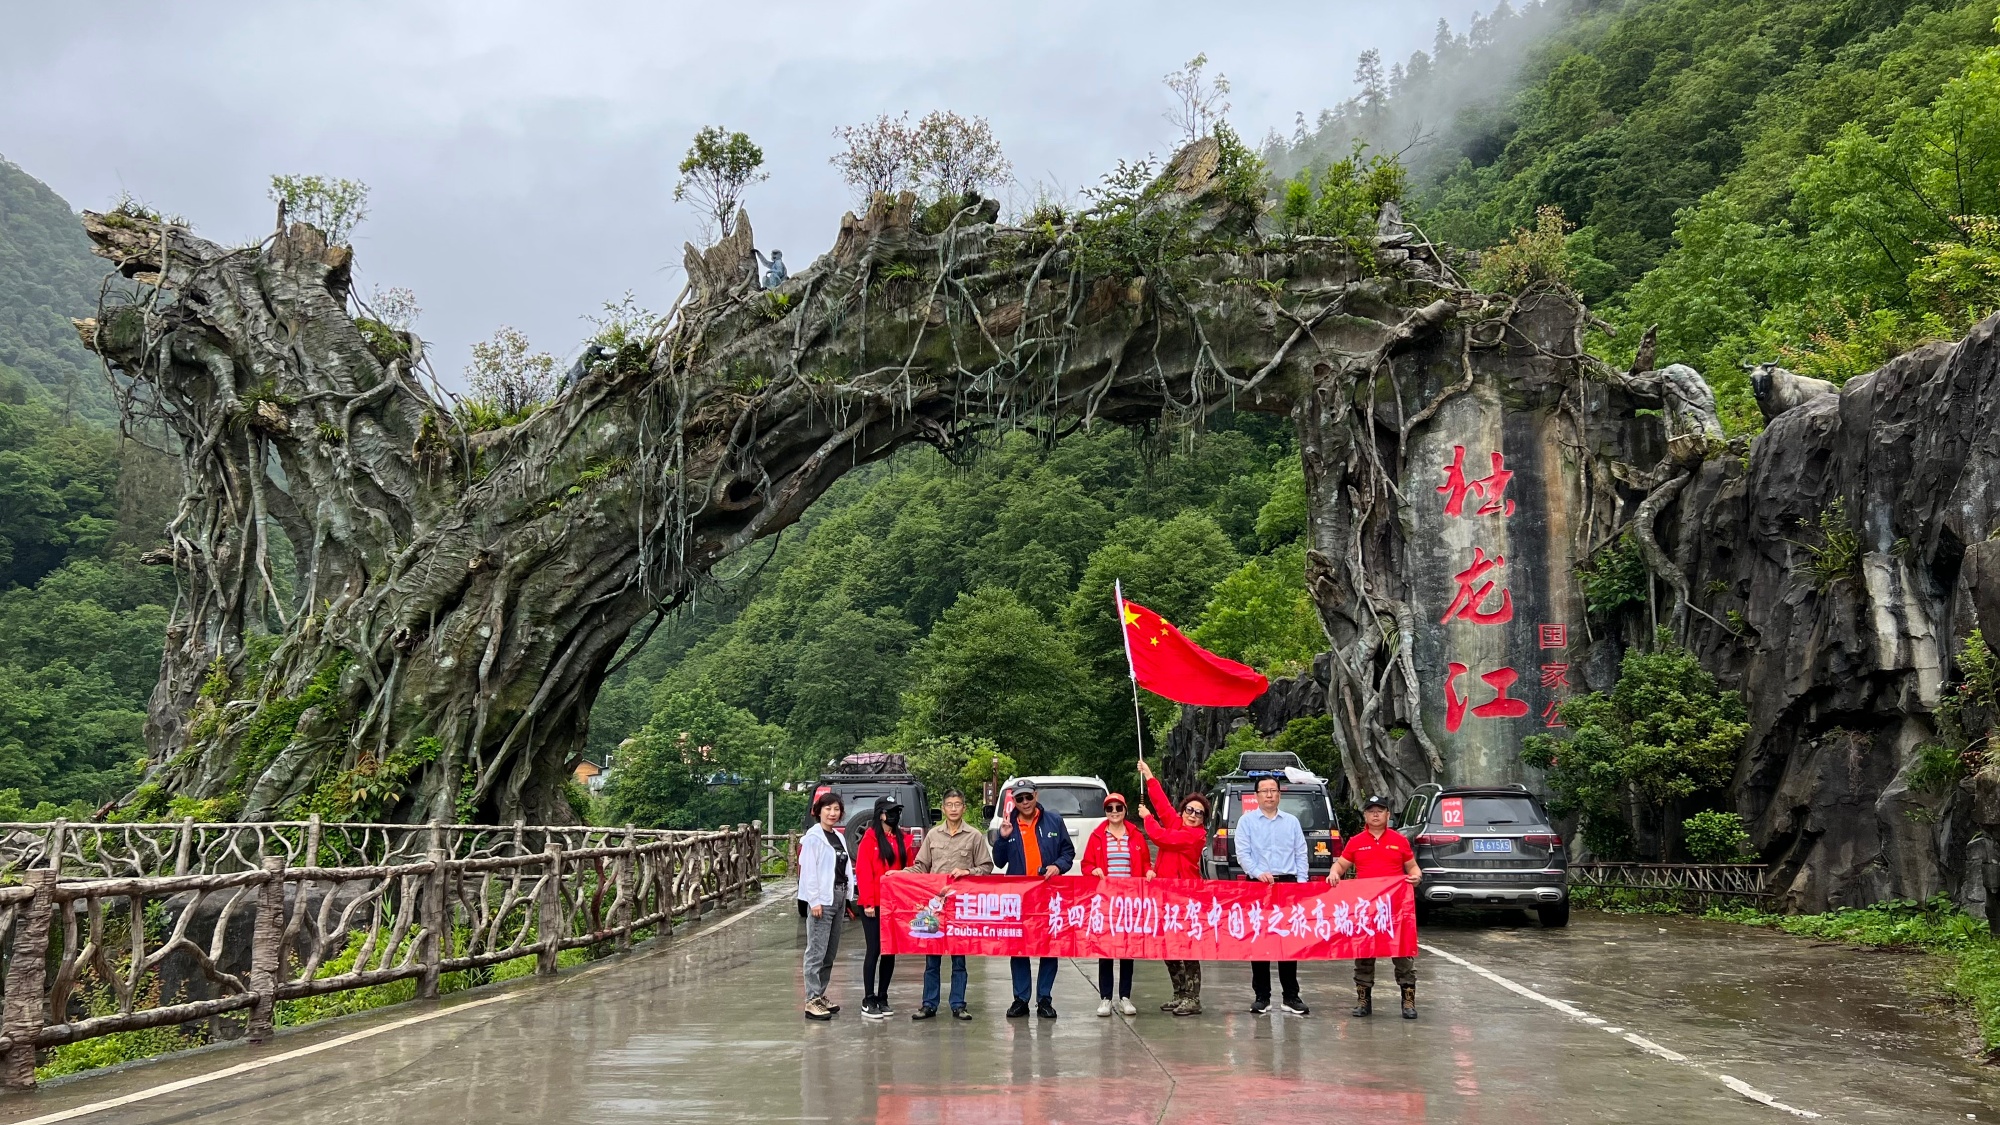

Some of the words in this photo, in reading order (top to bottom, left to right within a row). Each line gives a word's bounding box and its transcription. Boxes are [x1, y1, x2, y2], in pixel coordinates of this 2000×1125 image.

[1436, 445, 1529, 733] 独龙江
[1538, 623, 1570, 767] 国家公
[1444, 809, 1461, 823] 02
[955, 893, 1021, 921] 走吧网
[946, 925, 996, 937] Zouba.Cn
